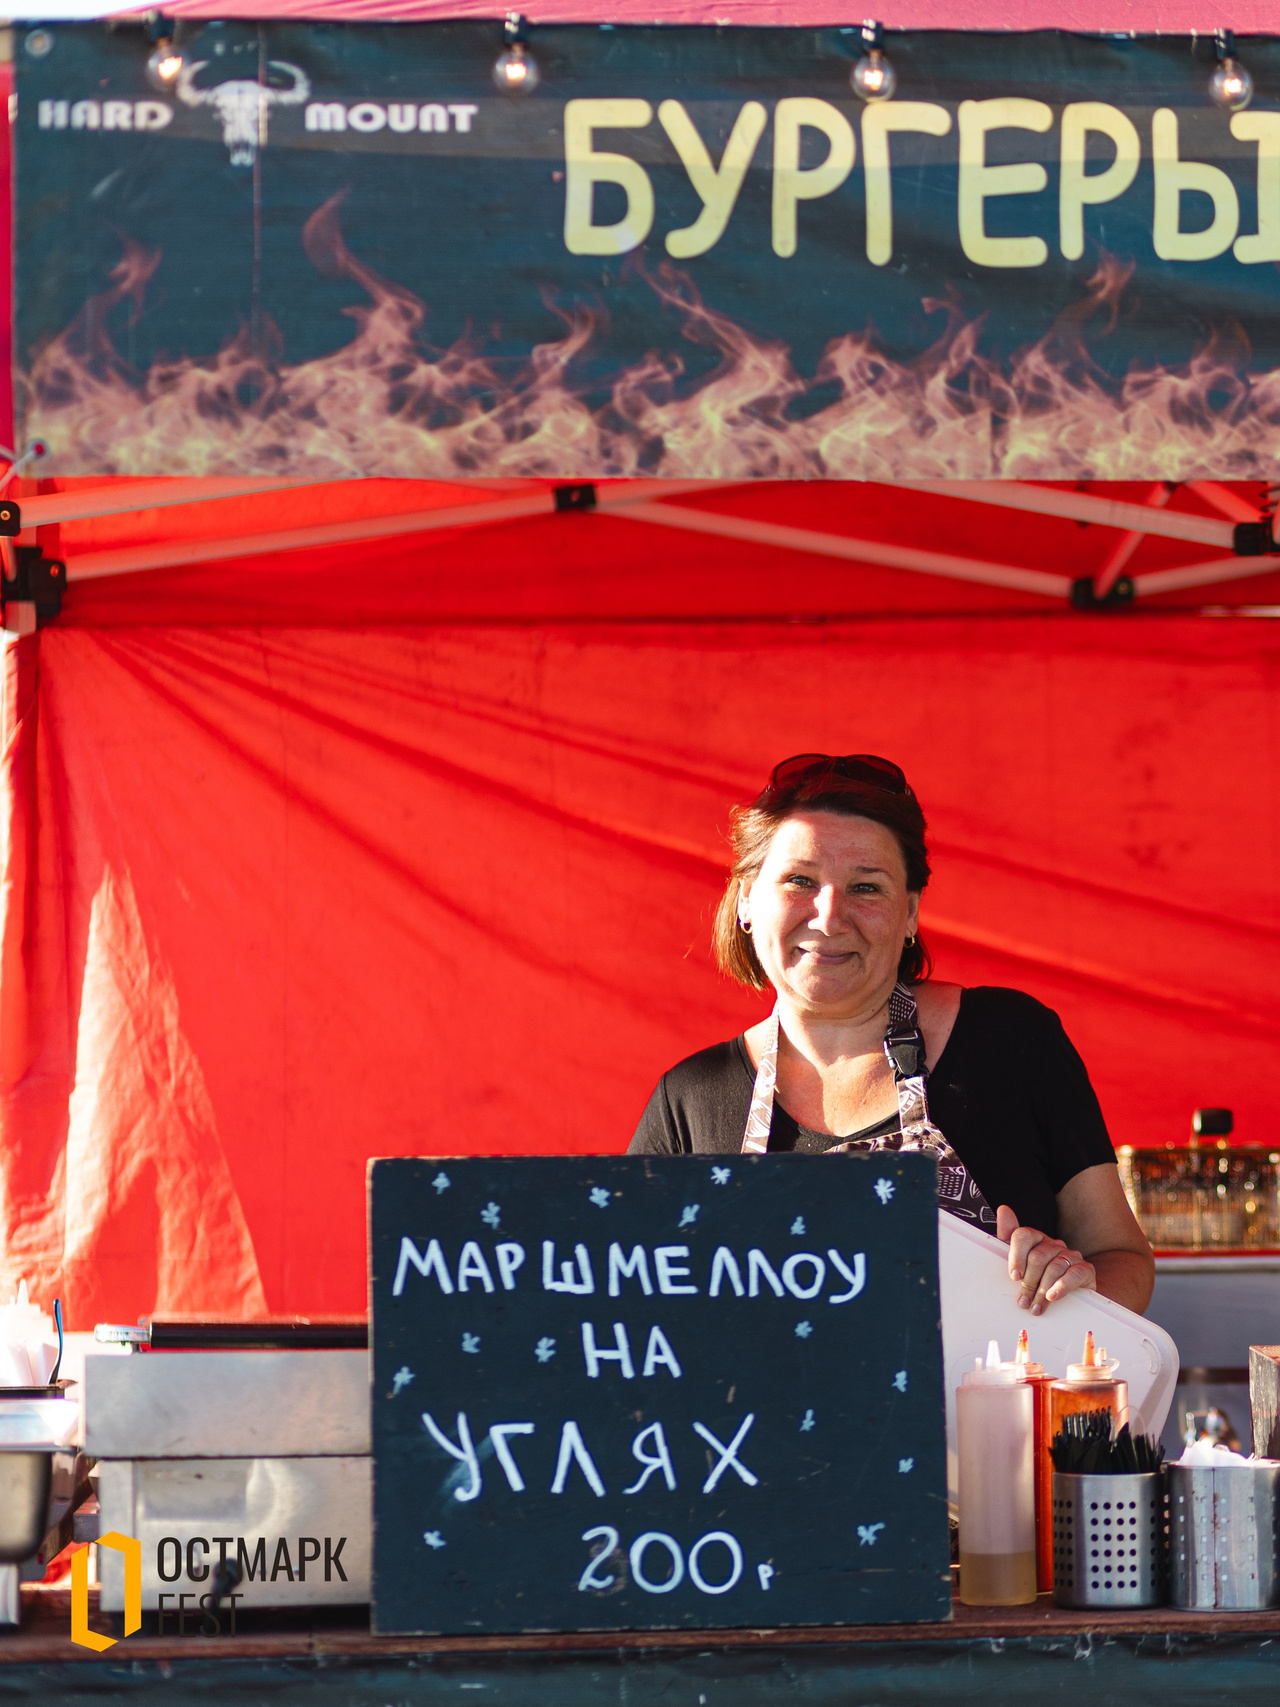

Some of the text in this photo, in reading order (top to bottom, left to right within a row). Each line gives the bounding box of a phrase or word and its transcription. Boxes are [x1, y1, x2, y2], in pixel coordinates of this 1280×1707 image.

[38, 100, 479, 134] HARD MOUNT
[392, 1236, 867, 1305] МАРШМЕЛЛОУ
[581, 1321, 682, 1379] НА
[421, 1411, 759, 1502] УГЛЯХ
